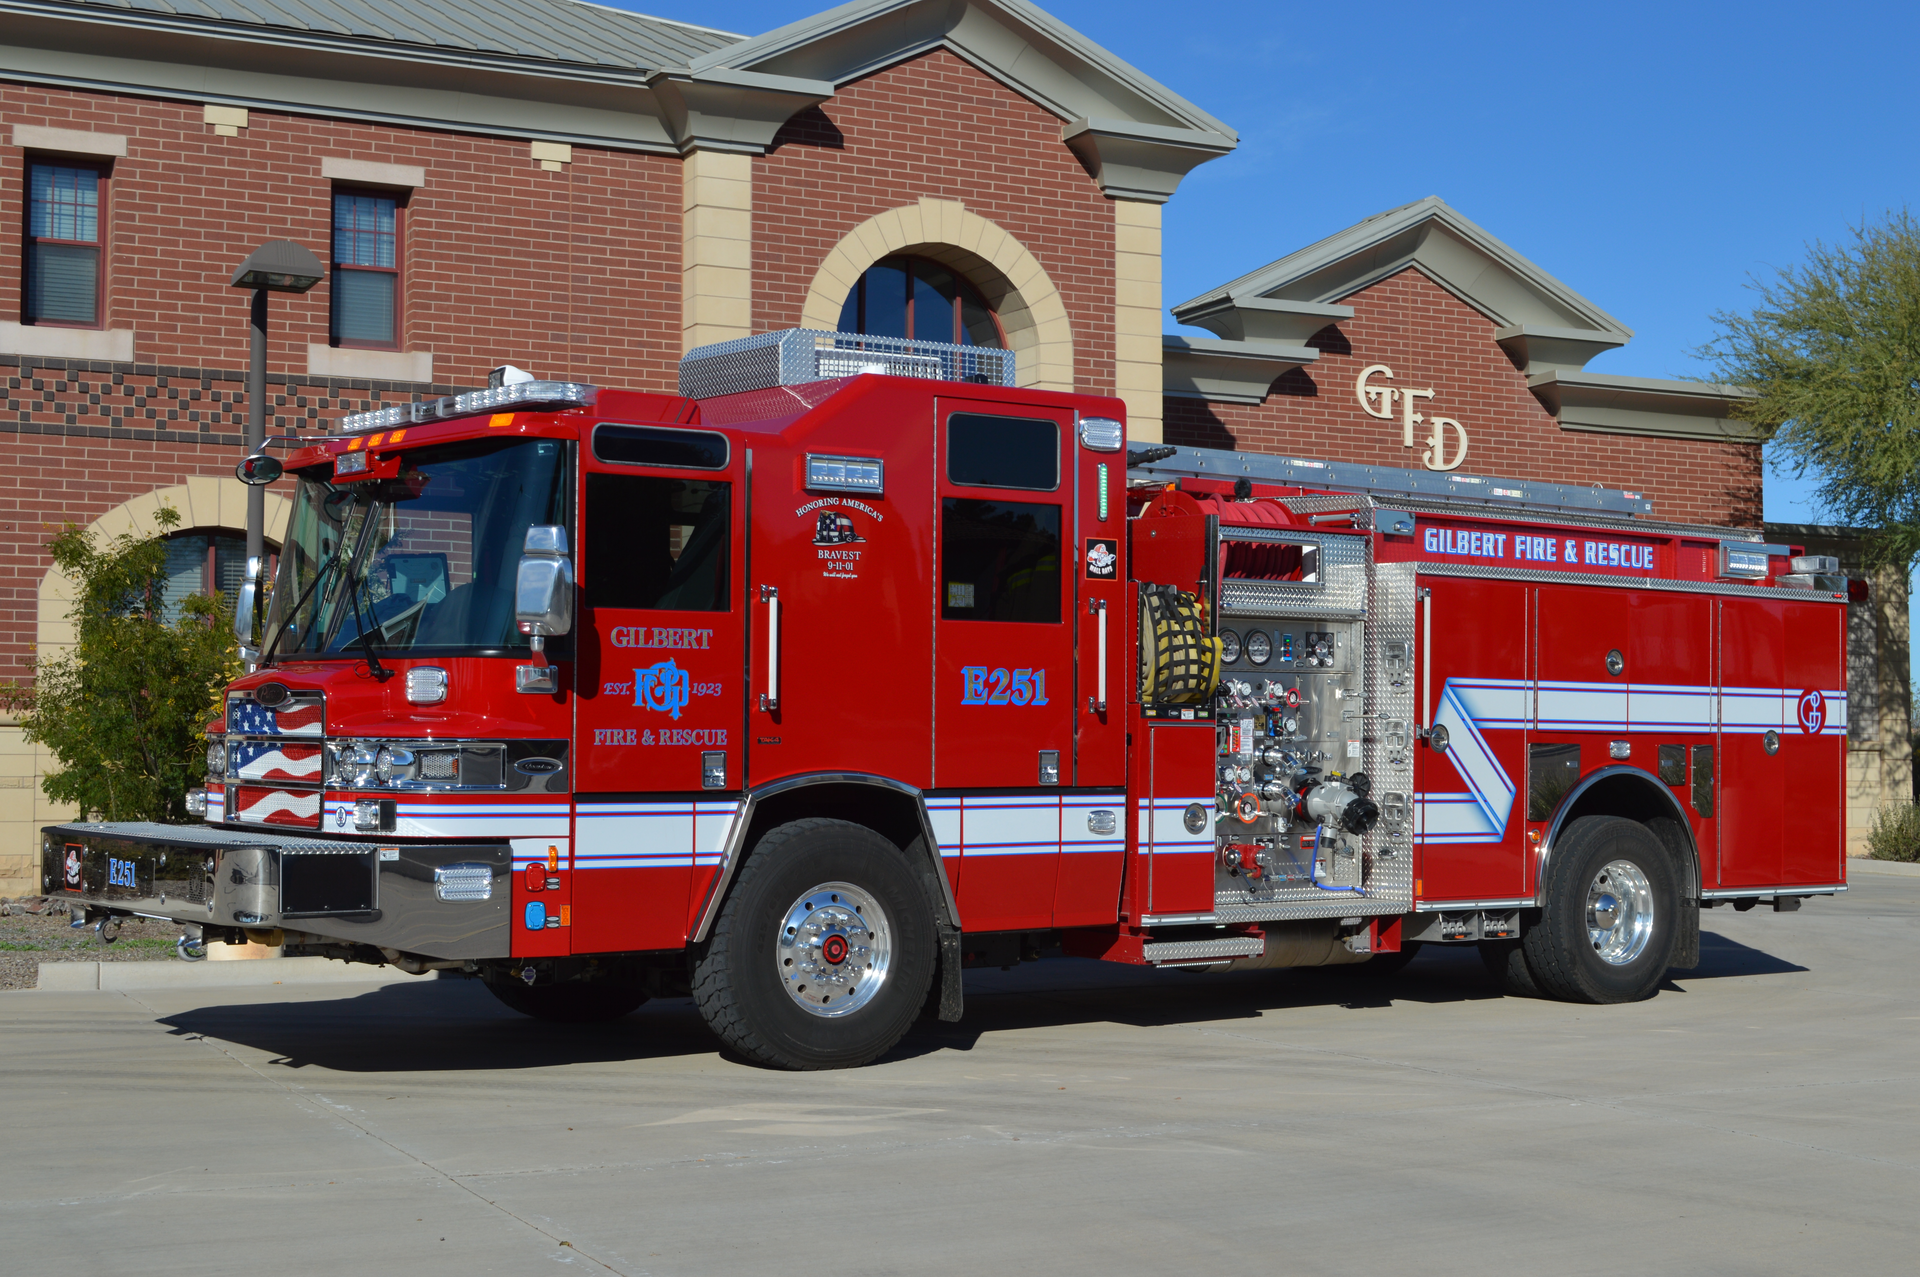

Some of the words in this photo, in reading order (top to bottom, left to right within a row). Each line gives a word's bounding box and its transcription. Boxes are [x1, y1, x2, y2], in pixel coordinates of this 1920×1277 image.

[1356, 364, 1469, 472] GFD
[795, 497, 840, 518] HONORING
[841, 498, 884, 522] AMERICA'S
[817, 549, 862, 561] BRAVEST
[1424, 527, 1507, 558] GILBERT
[1515, 535, 1557, 562] FIRE
[1564, 539, 1579, 565] &
[1584, 541, 1654, 570] RESCUE
[827, 561, 854, 571] 9-11-01
[610, 626, 713, 650] GILBERT
[603, 681, 632, 695] EST.
[691, 683, 722, 697] 1923
[960, 665, 1050, 706] E251
[593, 729, 637, 746] FIRE
[641, 729, 656, 746] &
[658, 729, 728, 746] RESCUE
[109, 857, 136, 888] E251
[885, 885, 916, 993] MICHELIN
